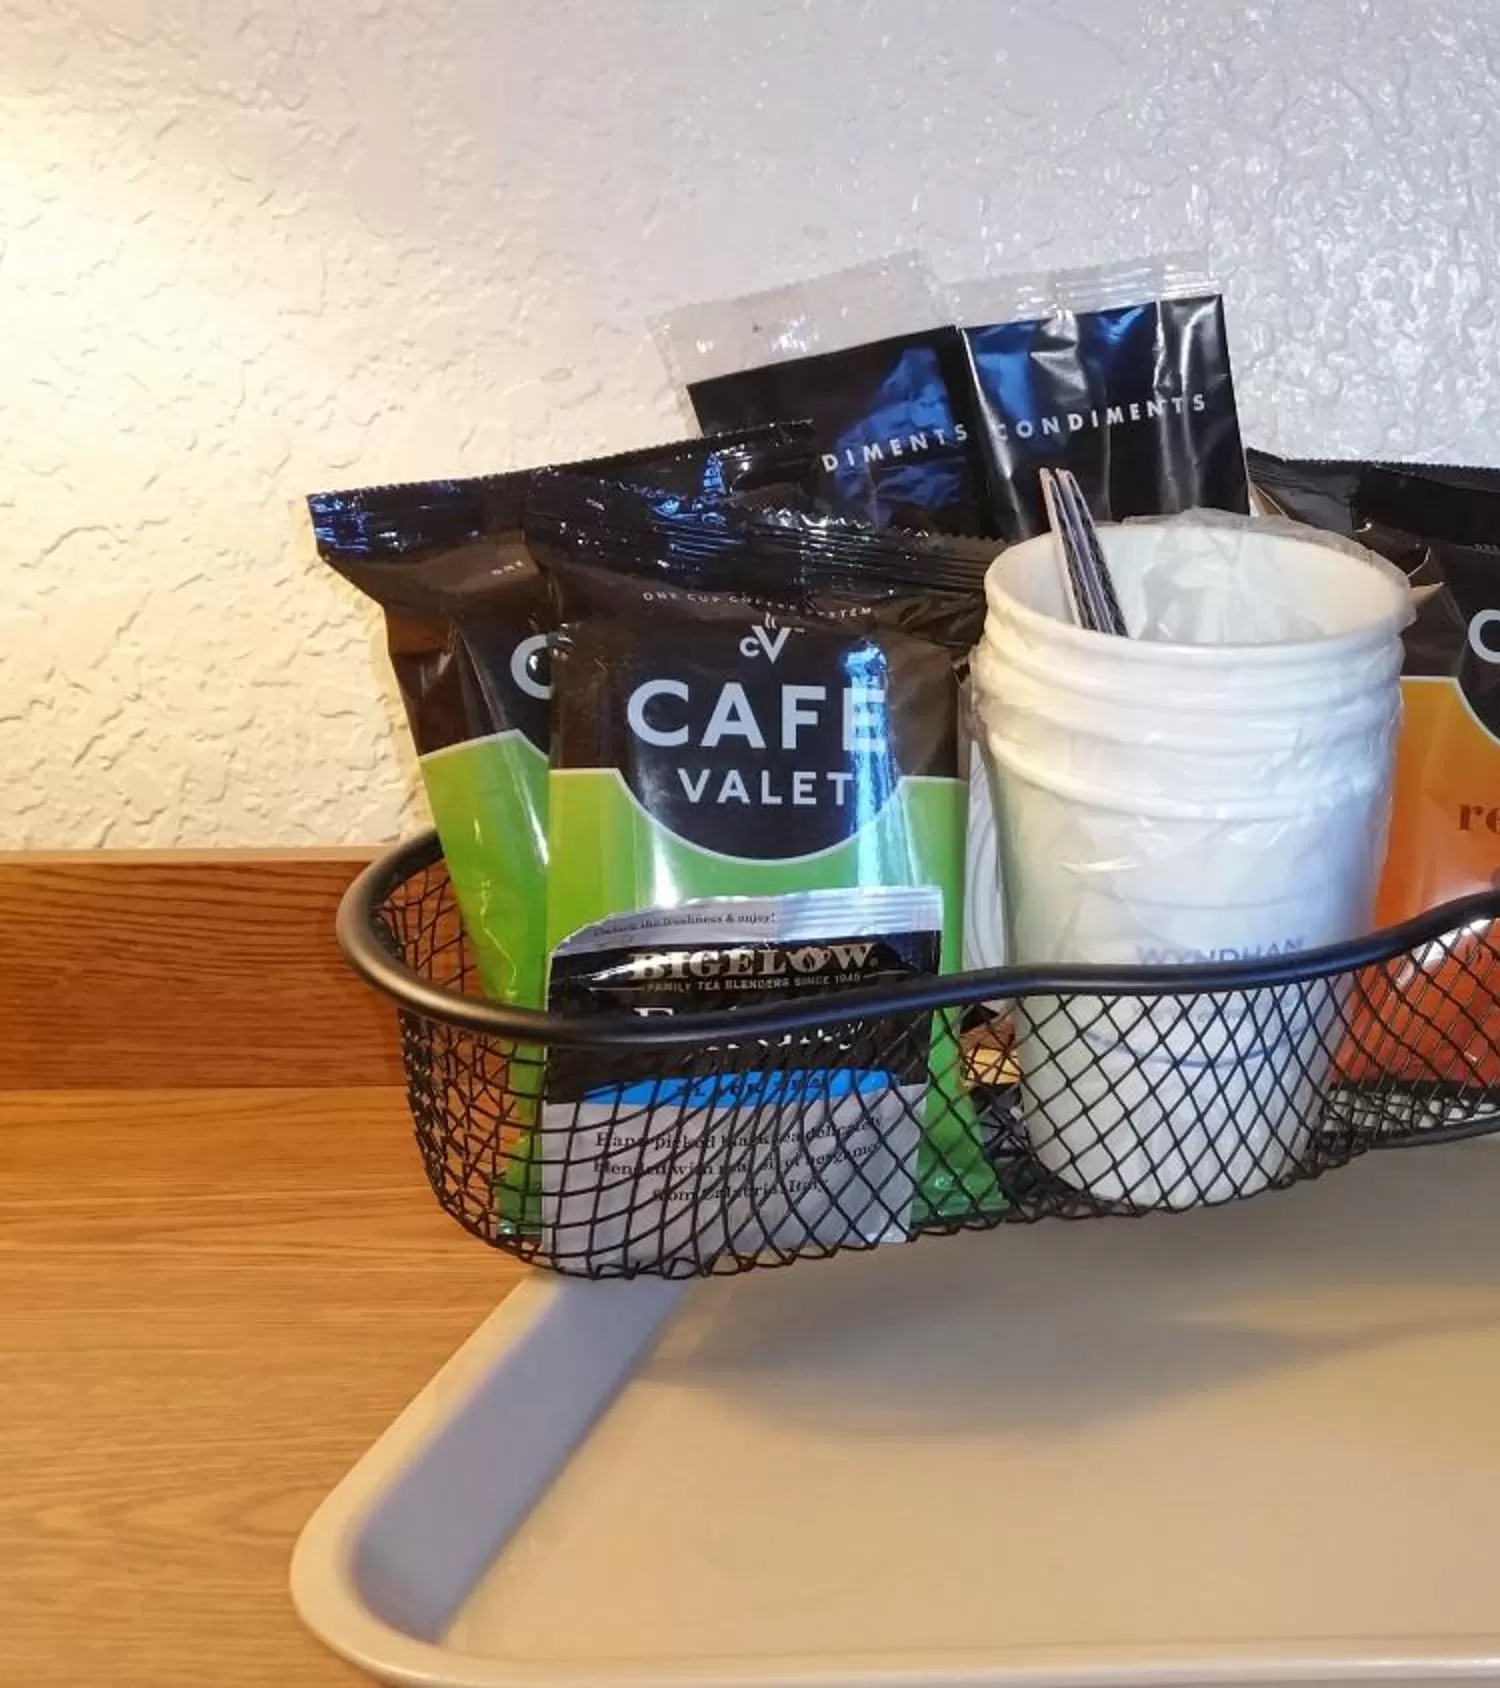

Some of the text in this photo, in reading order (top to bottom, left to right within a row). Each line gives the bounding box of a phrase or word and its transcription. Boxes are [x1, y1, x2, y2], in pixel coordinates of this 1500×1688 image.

[995, 394, 1205, 441] CONDIMENTS
[821, 423, 968, 472] DIMENTS
[626, 679, 886, 750] CAFE
[678, 768, 858, 806] VALET
[627, 942, 875, 980] BIGELOW
[647, 981, 691, 993] FAMILY
[698, 979, 720, 991] TEA
[725, 977, 789, 991] BLENDERS
[793, 974, 833, 986] SINCE
[672, 1161, 713, 1175] wih
[653, 1188, 698, 1201] fom
